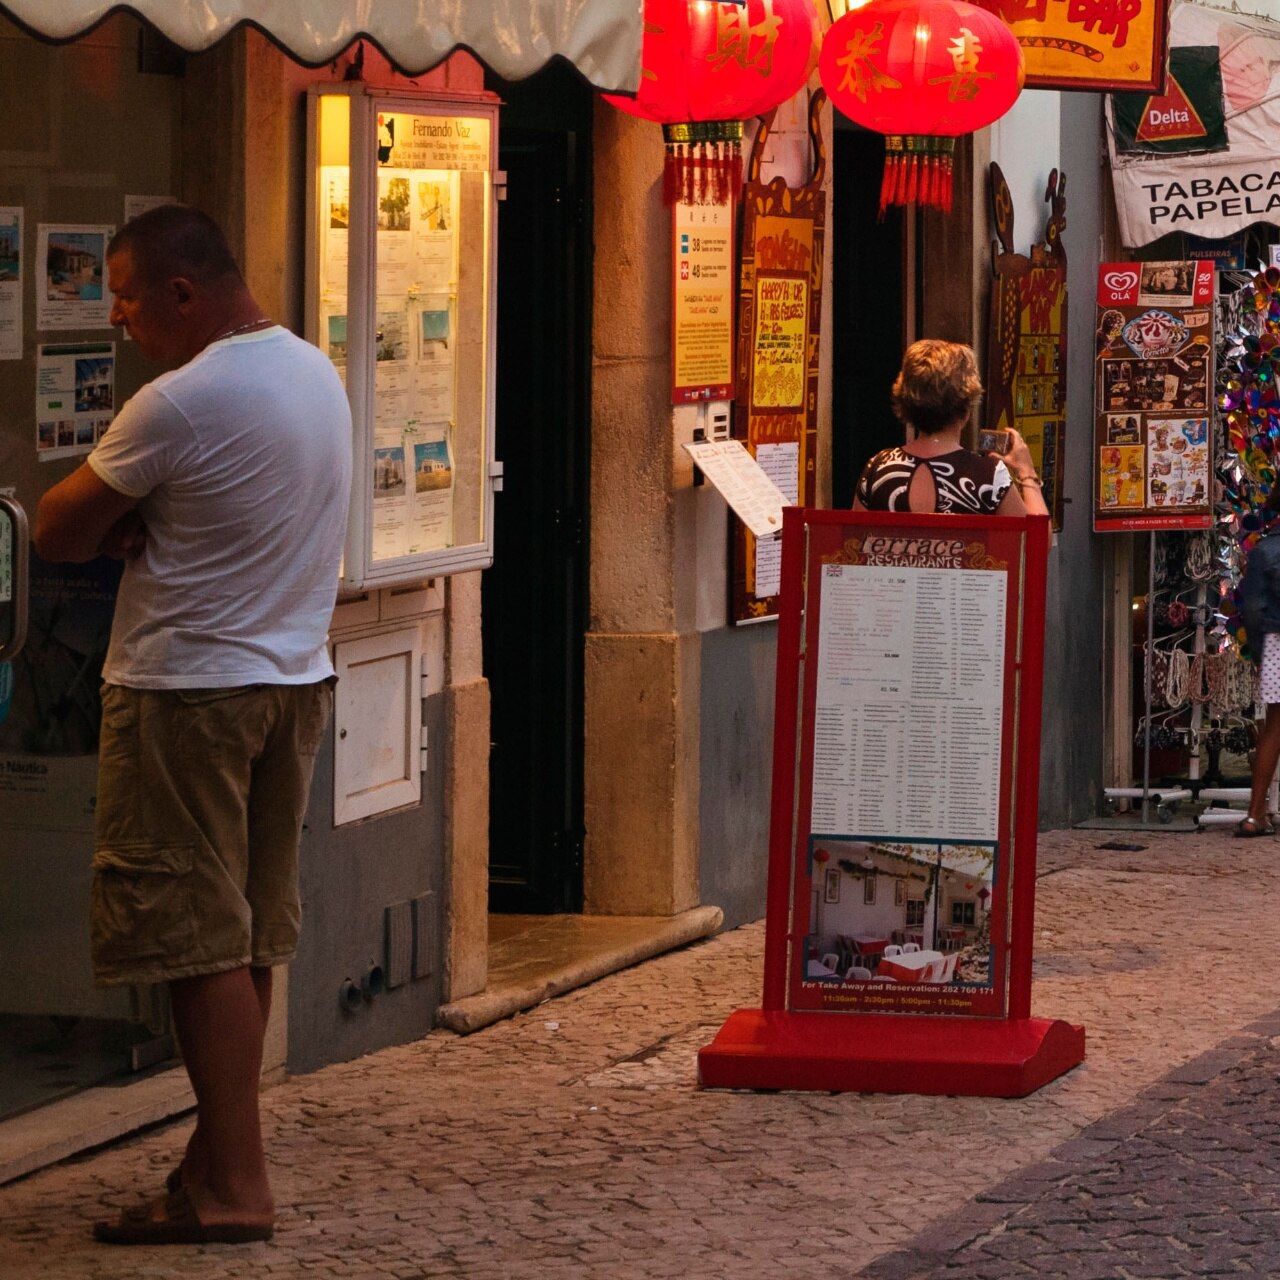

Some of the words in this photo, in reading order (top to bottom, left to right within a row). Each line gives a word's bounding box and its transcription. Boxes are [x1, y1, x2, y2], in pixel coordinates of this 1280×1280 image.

[1149, 108, 1190, 126] Delta
[412, 118, 453, 138] Fernando
[455, 121, 471, 138] Vaz
[1110, 289, 1131, 301] OLÁ
[1141, 346, 1170, 360] Cornetto
[859, 531, 965, 556] Terrace
[866, 553, 963, 569] RESTAURANTE
[801, 981, 816, 989] For
[818, 981, 839, 990] Take
[841, 982, 865, 992] Away
[866, 983, 883, 991] and
[885, 984, 940, 993] Reservation:
[942, 985, 959, 993] 282
[960, 986, 977, 994] 760
[979, 987, 994, 995] 171
